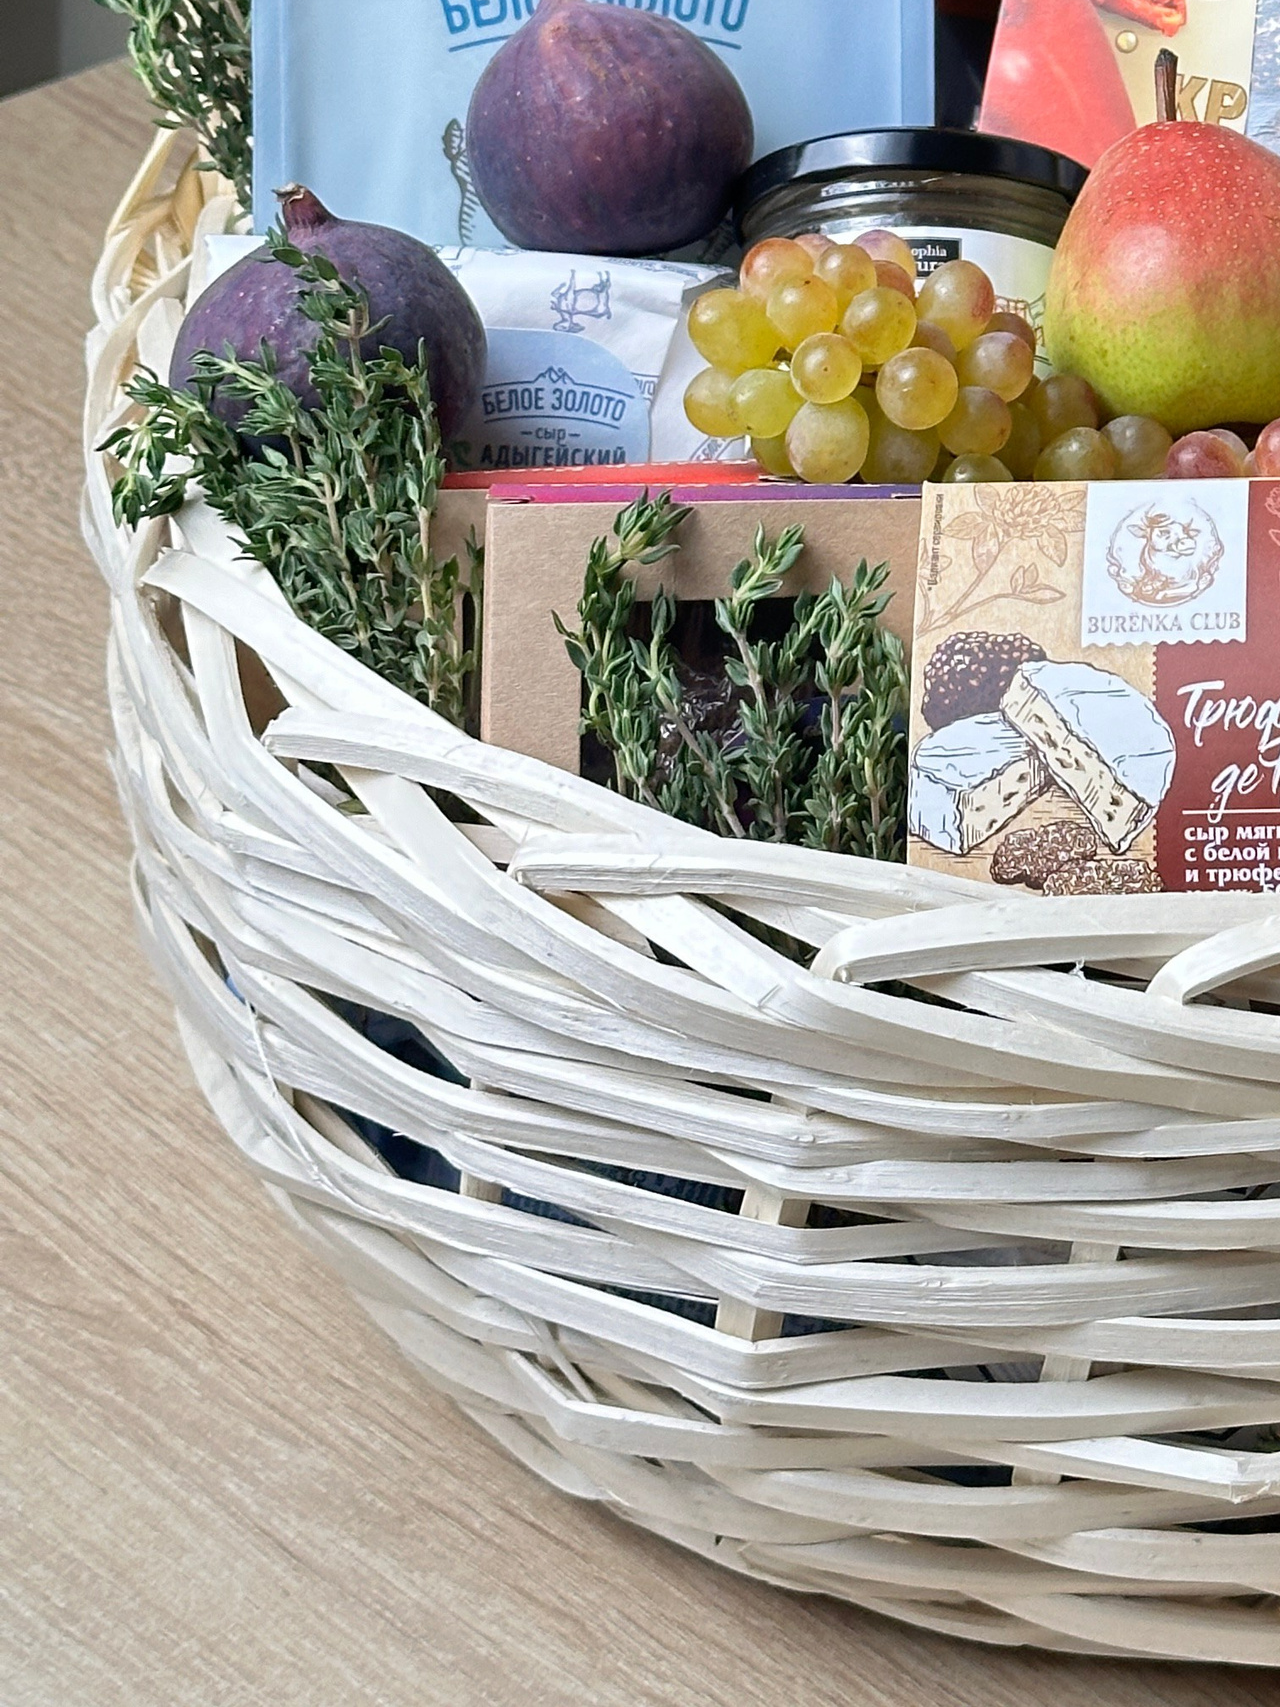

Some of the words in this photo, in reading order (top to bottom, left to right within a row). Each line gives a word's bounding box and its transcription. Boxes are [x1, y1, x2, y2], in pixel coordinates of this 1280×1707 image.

[911, 245, 947, 260] ophia
[482, 388, 545, 415] БЕЛОЕ
[551, 387, 626, 422] ЗОЛОТО
[535, 427, 567, 445] сыр
[480, 444, 627, 467] АДЫГЕЙСКИЙ
[1190, 611, 1241, 631] CLUB
[1207, 763, 1265, 823] де
[1184, 826, 1229, 845] сыр
[1184, 848, 1197, 861] с
[1203, 842, 1270, 862] белой
[1185, 869, 1199, 883] и
